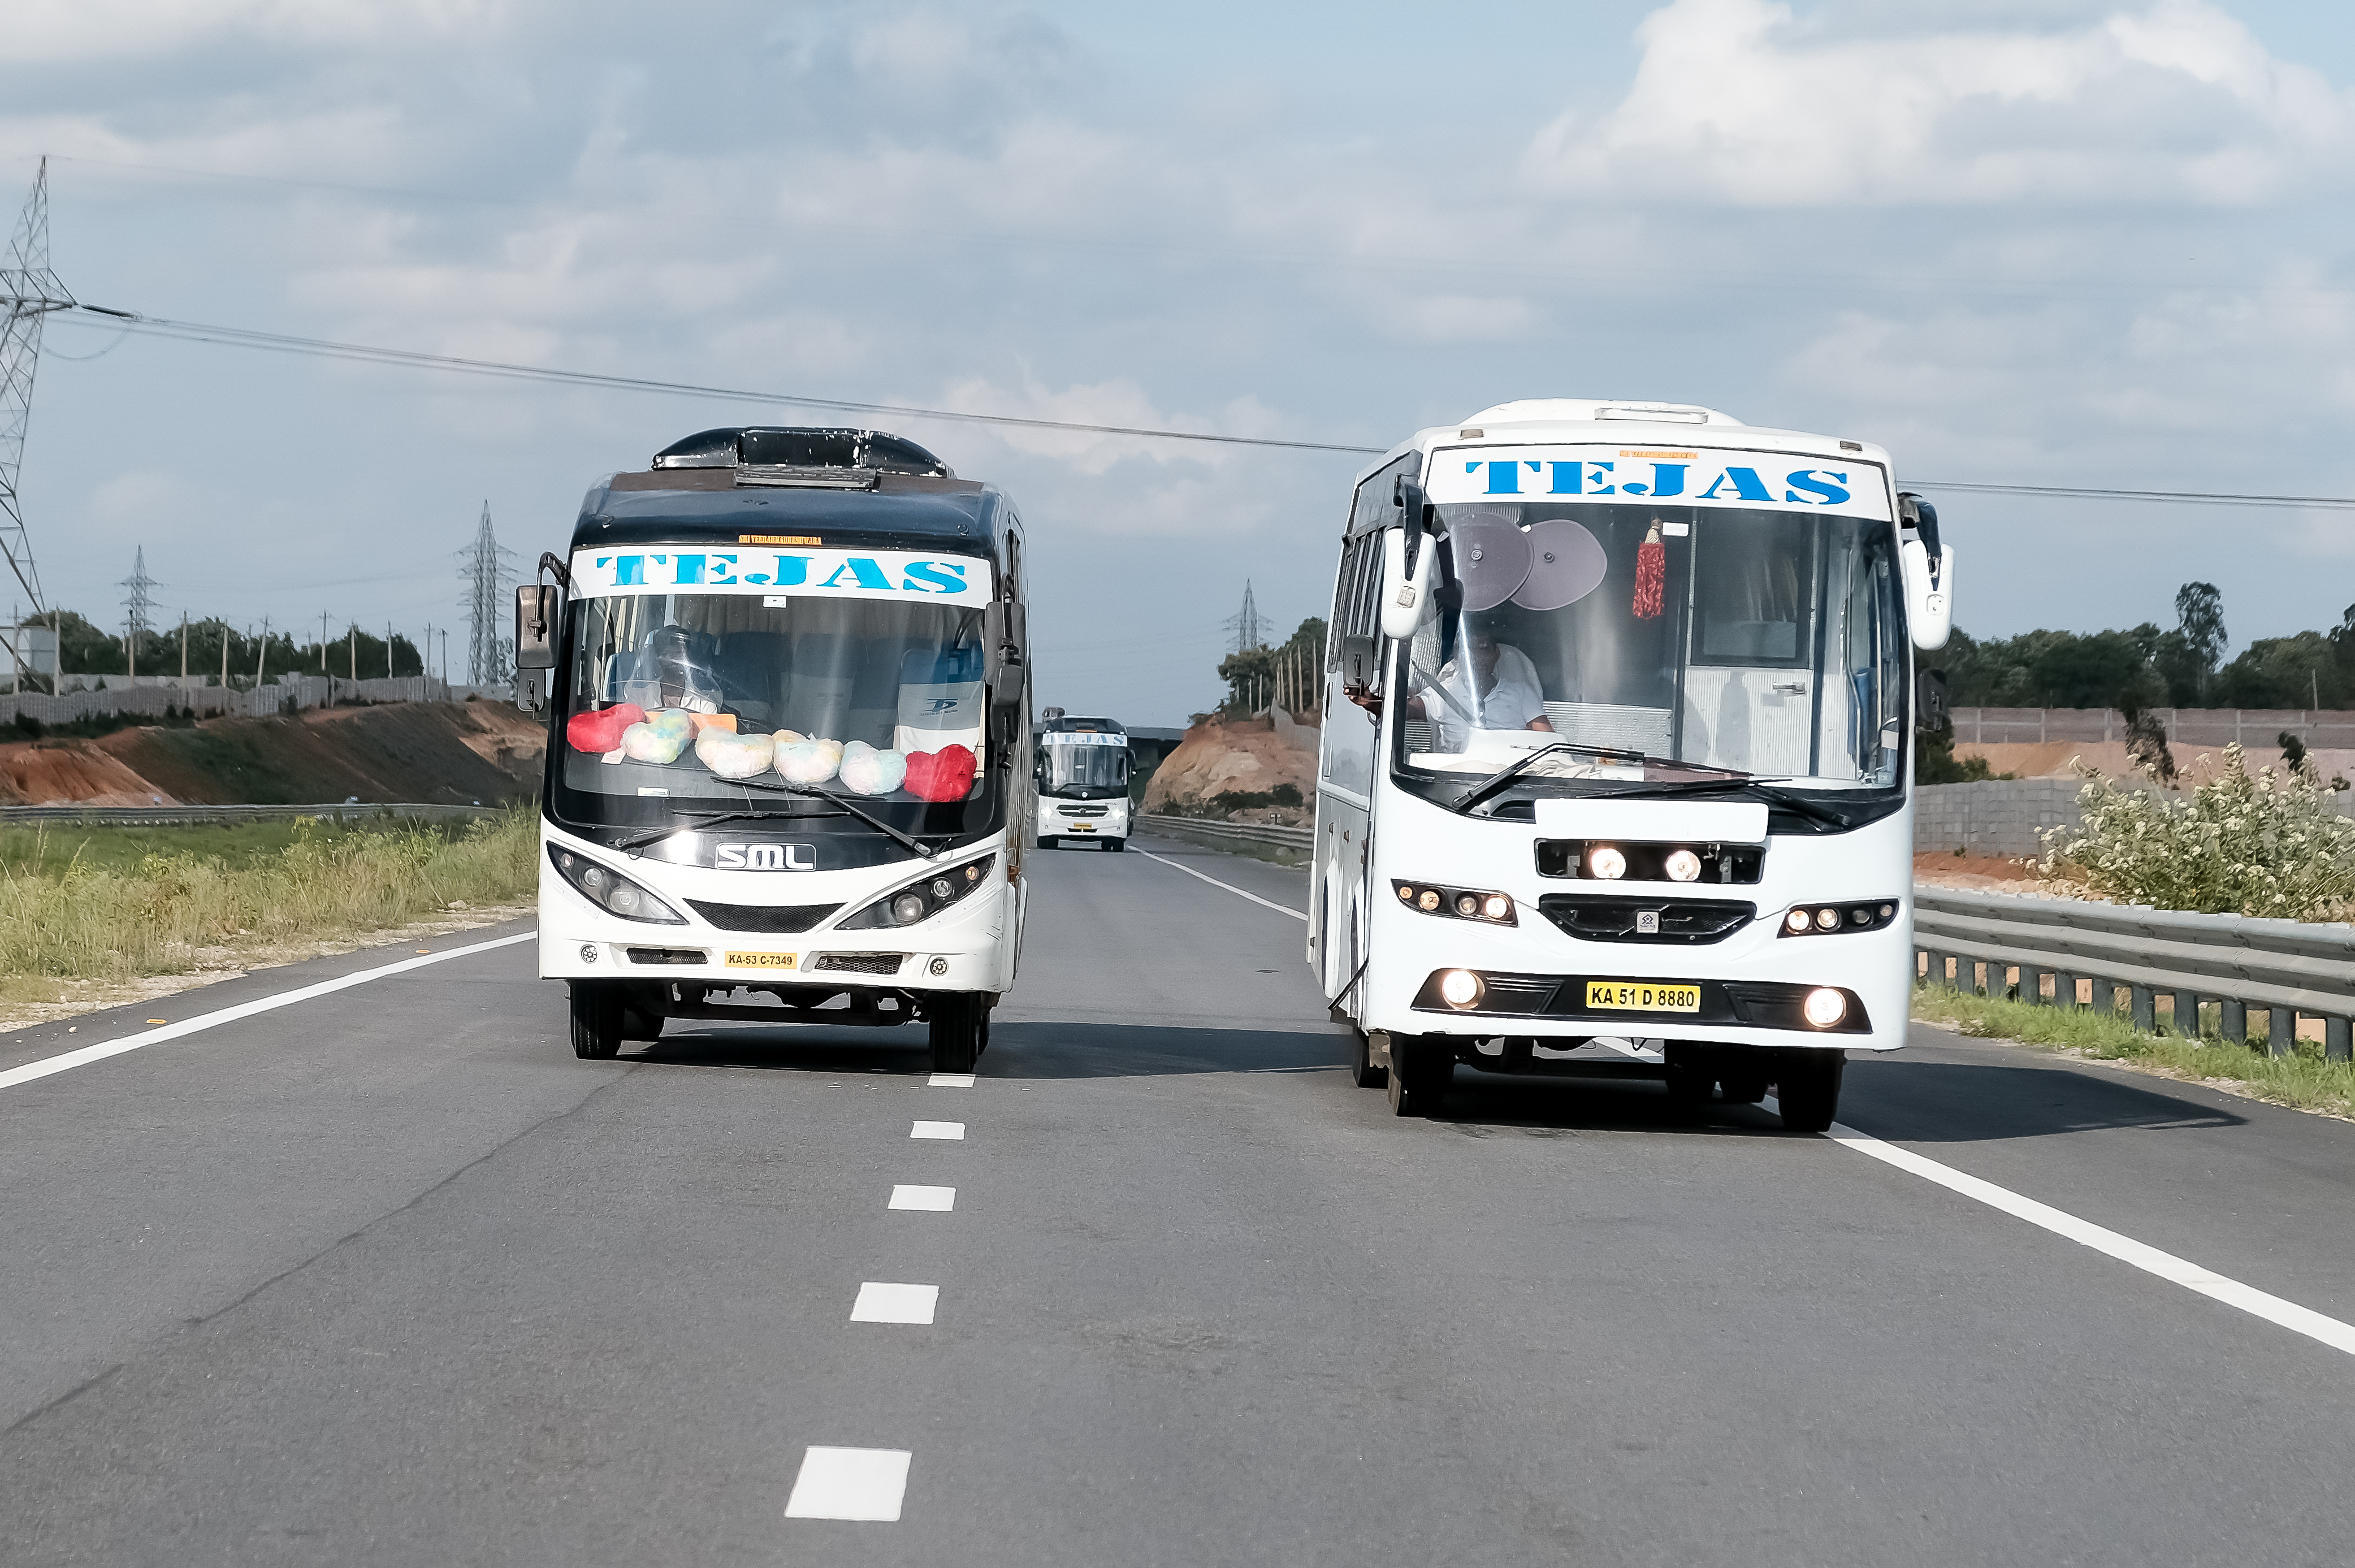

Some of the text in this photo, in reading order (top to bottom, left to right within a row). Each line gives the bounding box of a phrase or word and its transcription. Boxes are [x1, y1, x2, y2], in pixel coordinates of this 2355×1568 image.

[1466, 461, 1850, 505] TEJAS
[596, 554, 967, 594] TEJAS
[717, 843, 814, 870] SML
[729, 955, 793, 965] KA-53 C-7349
[1592, 987, 1694, 1007] KA 51 D 8880
